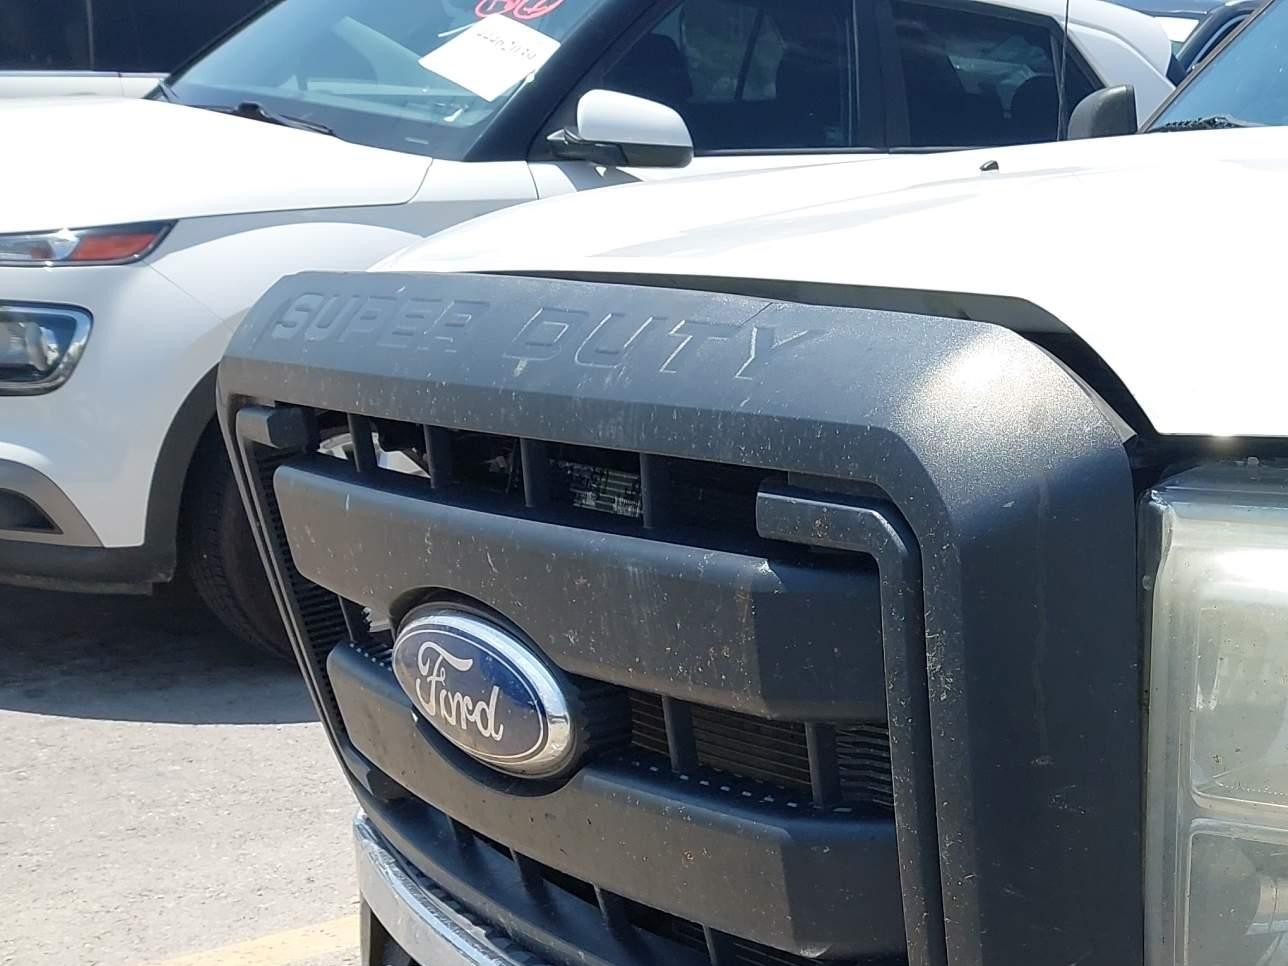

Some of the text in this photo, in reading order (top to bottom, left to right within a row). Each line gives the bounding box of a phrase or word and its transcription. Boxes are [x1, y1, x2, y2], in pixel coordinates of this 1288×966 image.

[268, 291, 826, 381] SUPER DUTY
[416, 641, 504, 742] Ford
